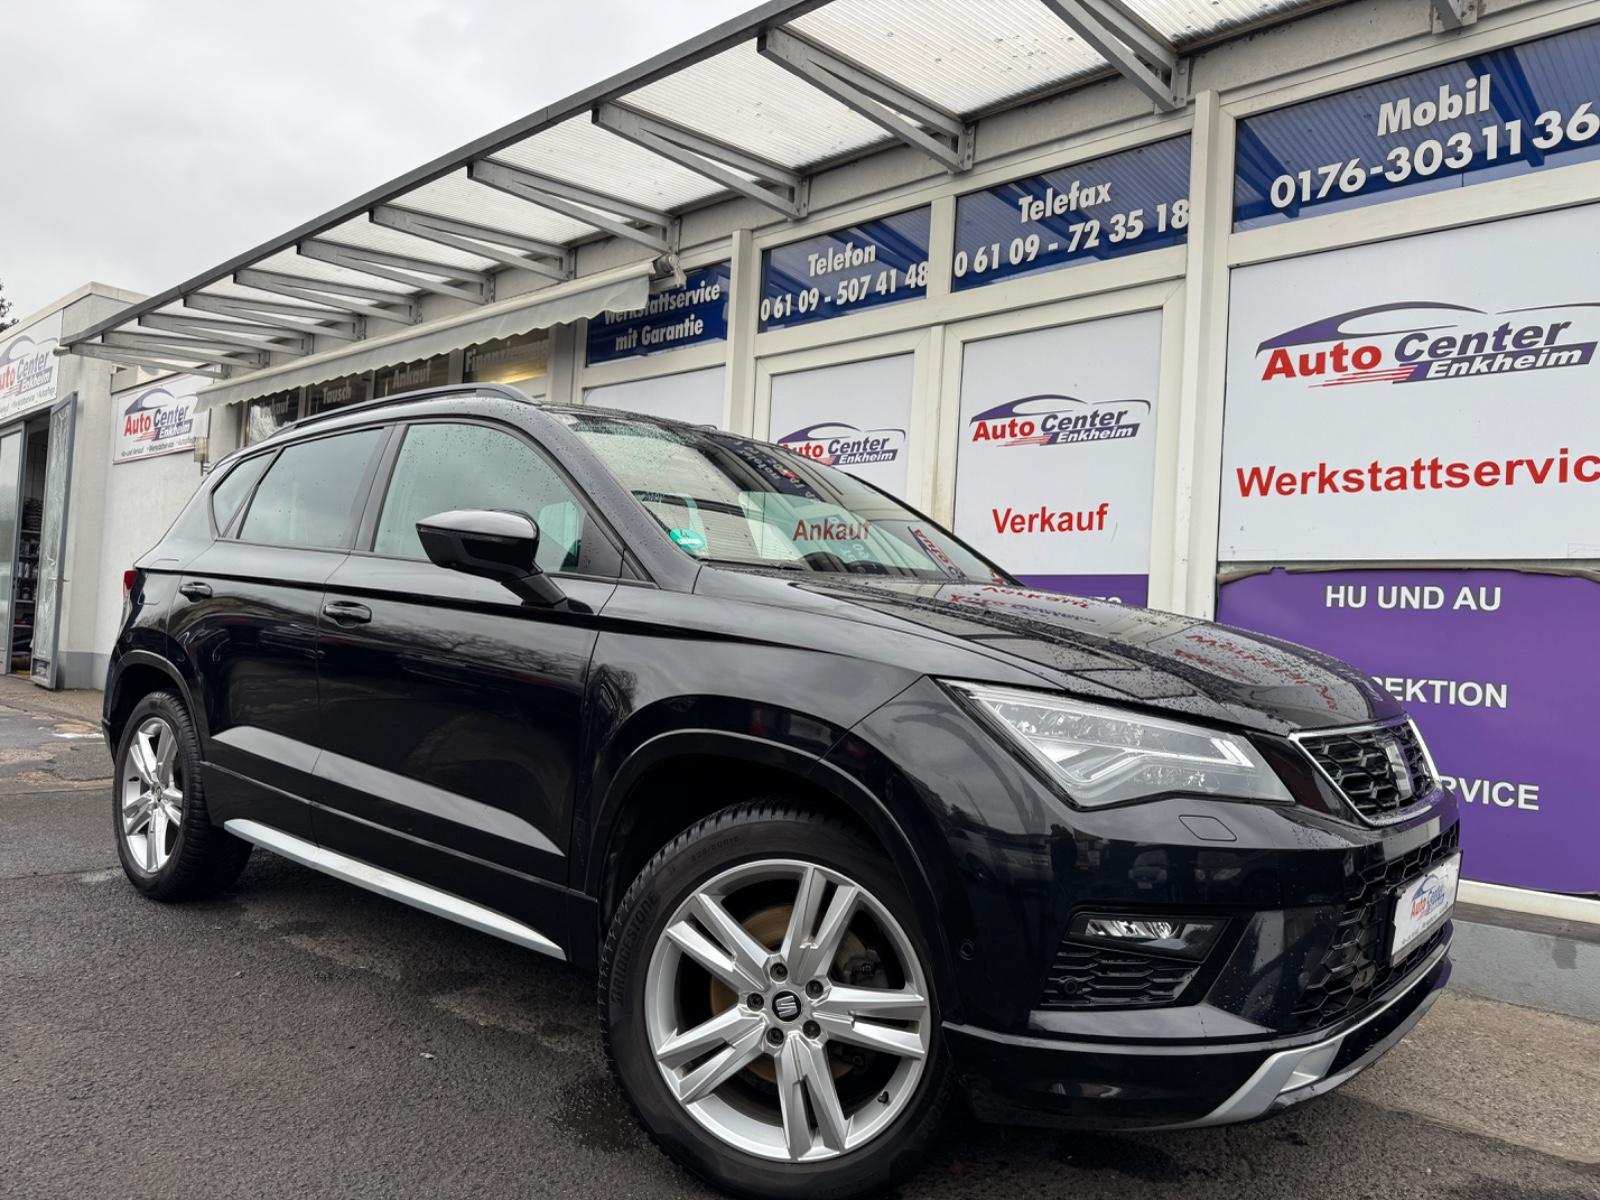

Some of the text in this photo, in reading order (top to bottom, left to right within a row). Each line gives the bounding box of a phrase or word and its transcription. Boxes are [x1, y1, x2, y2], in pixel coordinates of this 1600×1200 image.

[1376, 74, 1491, 137] Mobil
[1018, 180, 1112, 224] Telefax
[954, 251, 968, 278] 0
[973, 243, 1000, 273] 61
[1009, 234, 1040, 265] 09
[1067, 219, 1100, 253] 72
[1109, 208, 1143, 243] 35
[1156, 199, 1189, 232] 18
[808, 242, 876, 277] Telefon
[760, 298, 770, 321] 0
[774, 293, 791, 319] 61
[799, 288, 820, 313] 09
[836, 274, 871, 305] 507
[876, 268, 897, 295] 41
[905, 261, 928, 289] 48
[615, 313, 704, 351] mit Garantie
[17, 351, 49, 379] Center
[1261, 320, 1572, 381] Auto Center
[1425, 348, 1582, 379] Enkheim
[124, 405, 190, 437] Auto Center
[972, 409, 1128, 442] Auto Center
[1056, 427, 1133, 444] Enkheim
[783, 436, 890, 459] uto Center
[839, 450, 893, 465] Enkheim
[793, 518, 869, 541] Ankauf
[992, 502, 1109, 534] Verkauf
[1325, 585, 1501, 611] HU UND AU
[609, 890, 658, 1006] BRIDGESTONE
